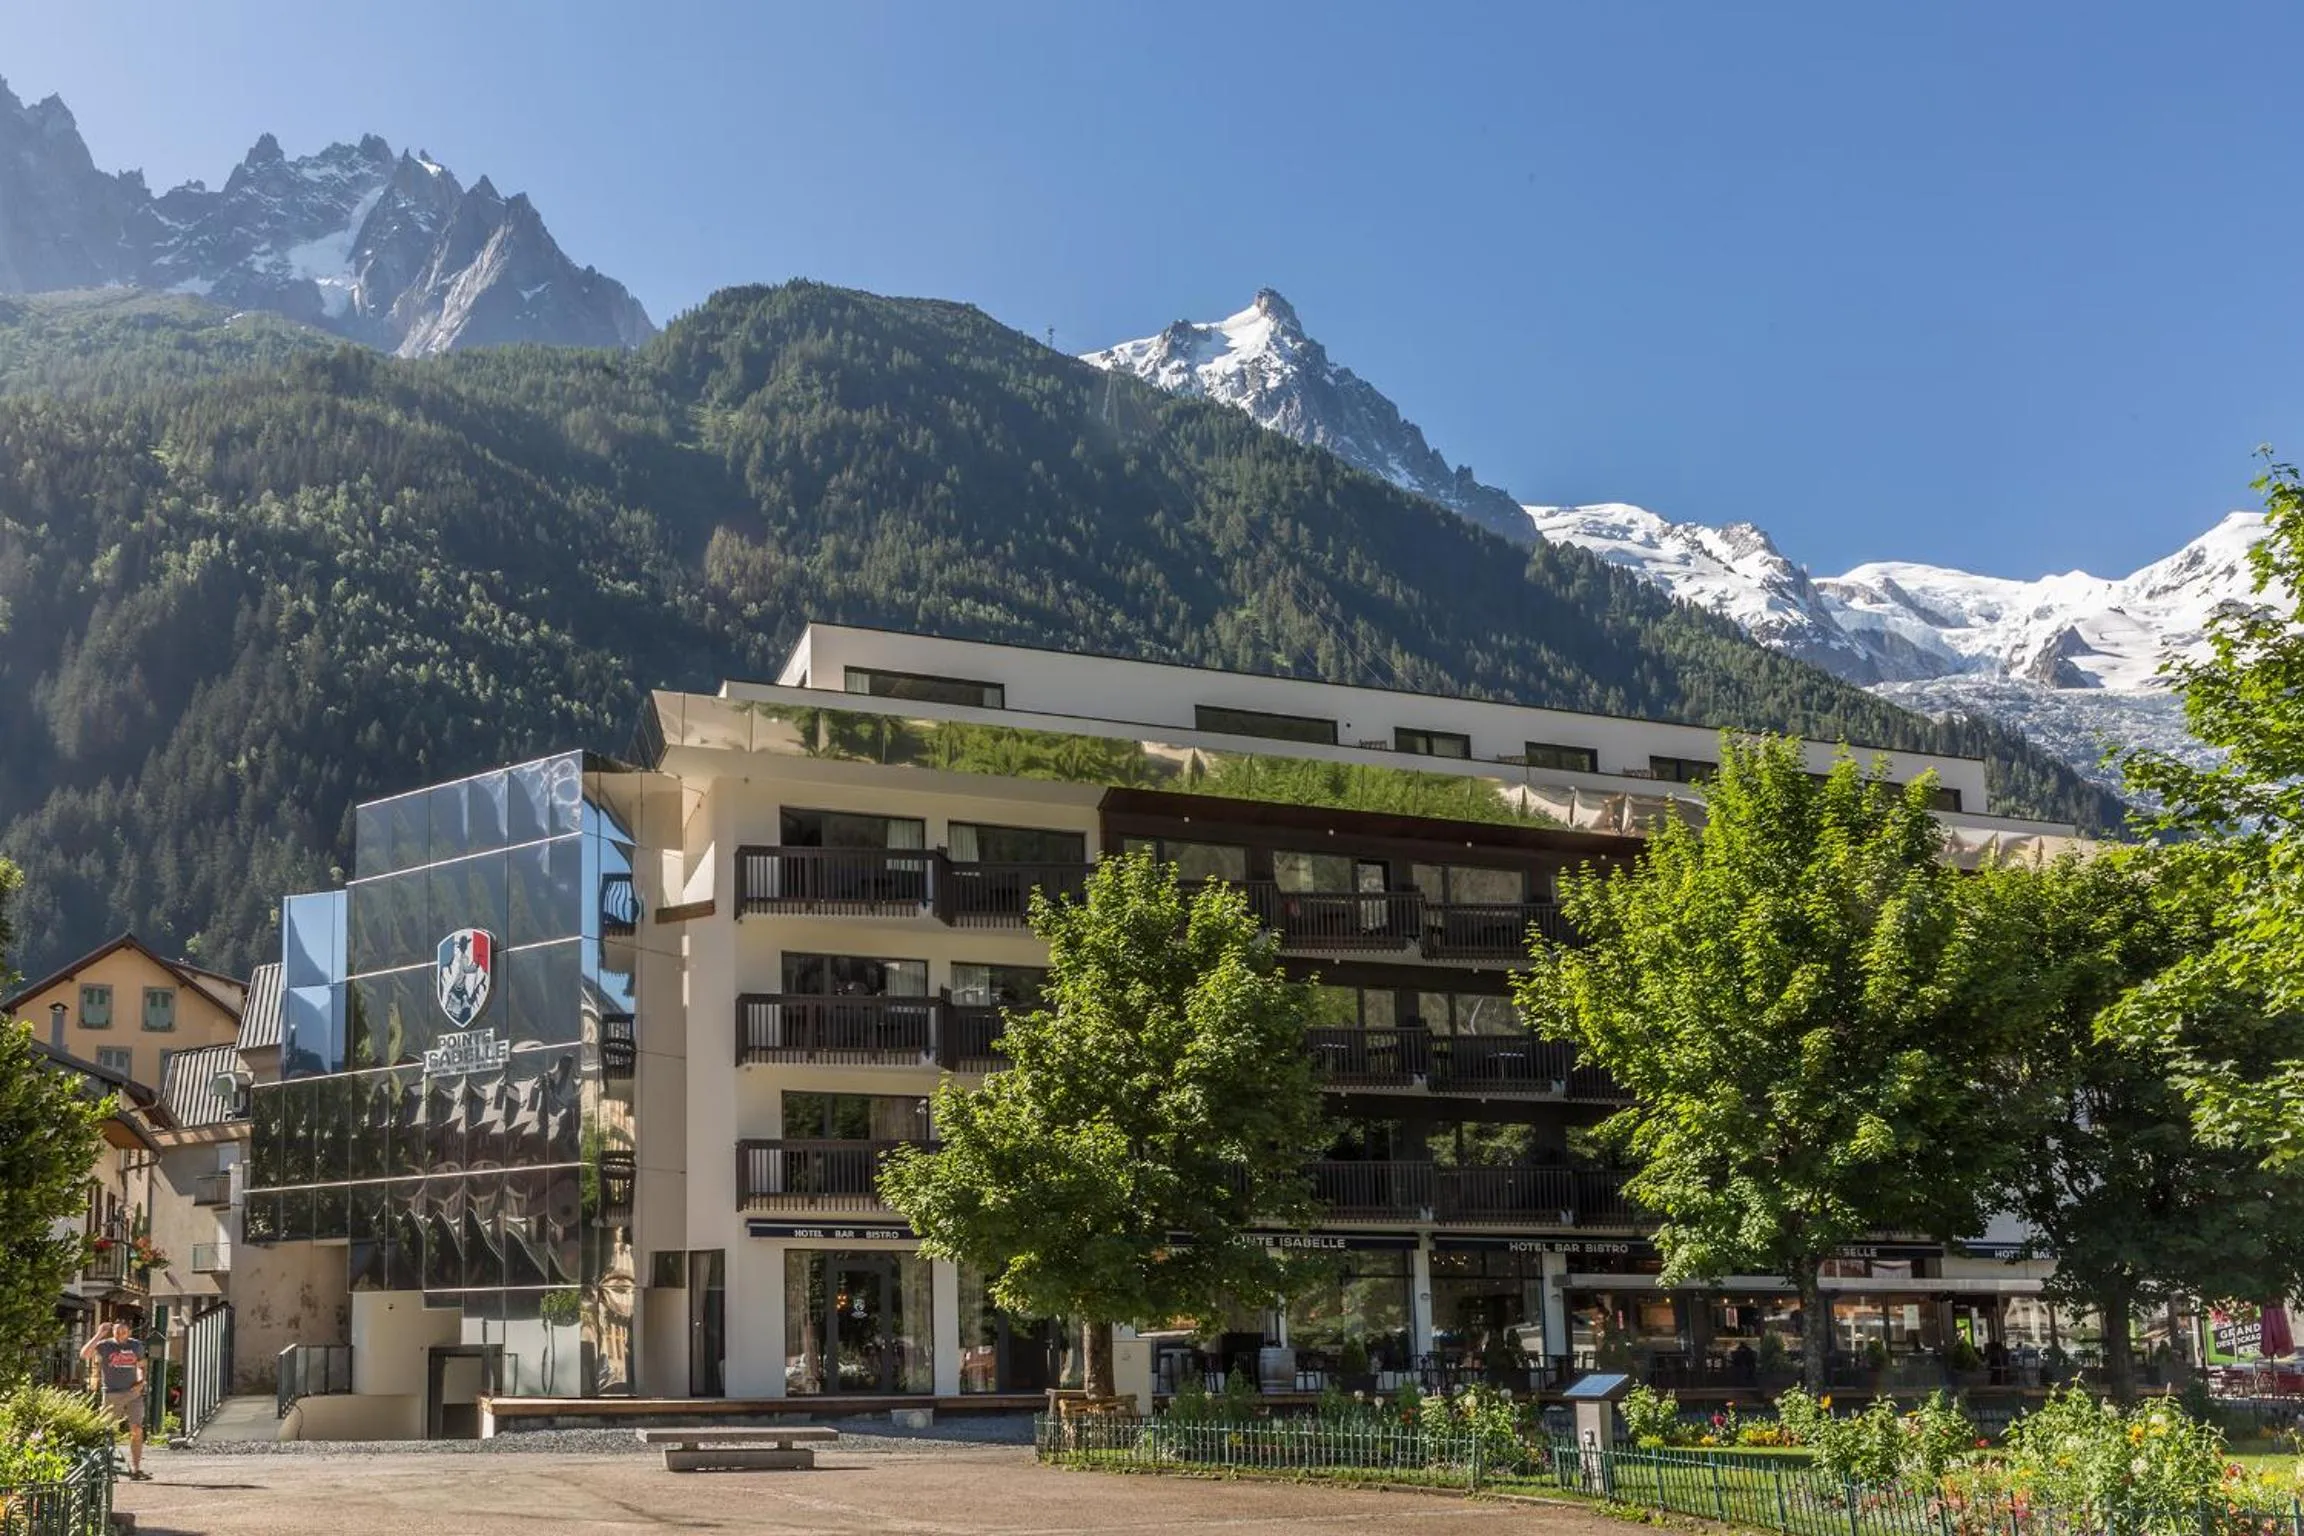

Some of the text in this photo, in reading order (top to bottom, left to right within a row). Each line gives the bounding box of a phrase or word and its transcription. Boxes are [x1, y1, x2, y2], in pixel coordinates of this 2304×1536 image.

[794, 1230, 824, 1238] HOTEL
[866, 1231, 899, 1239] BISTRO
[1509, 1242, 1629, 1253] HOTEL BAR BISTRO
[2220, 1323, 2262, 1339] GRAND
